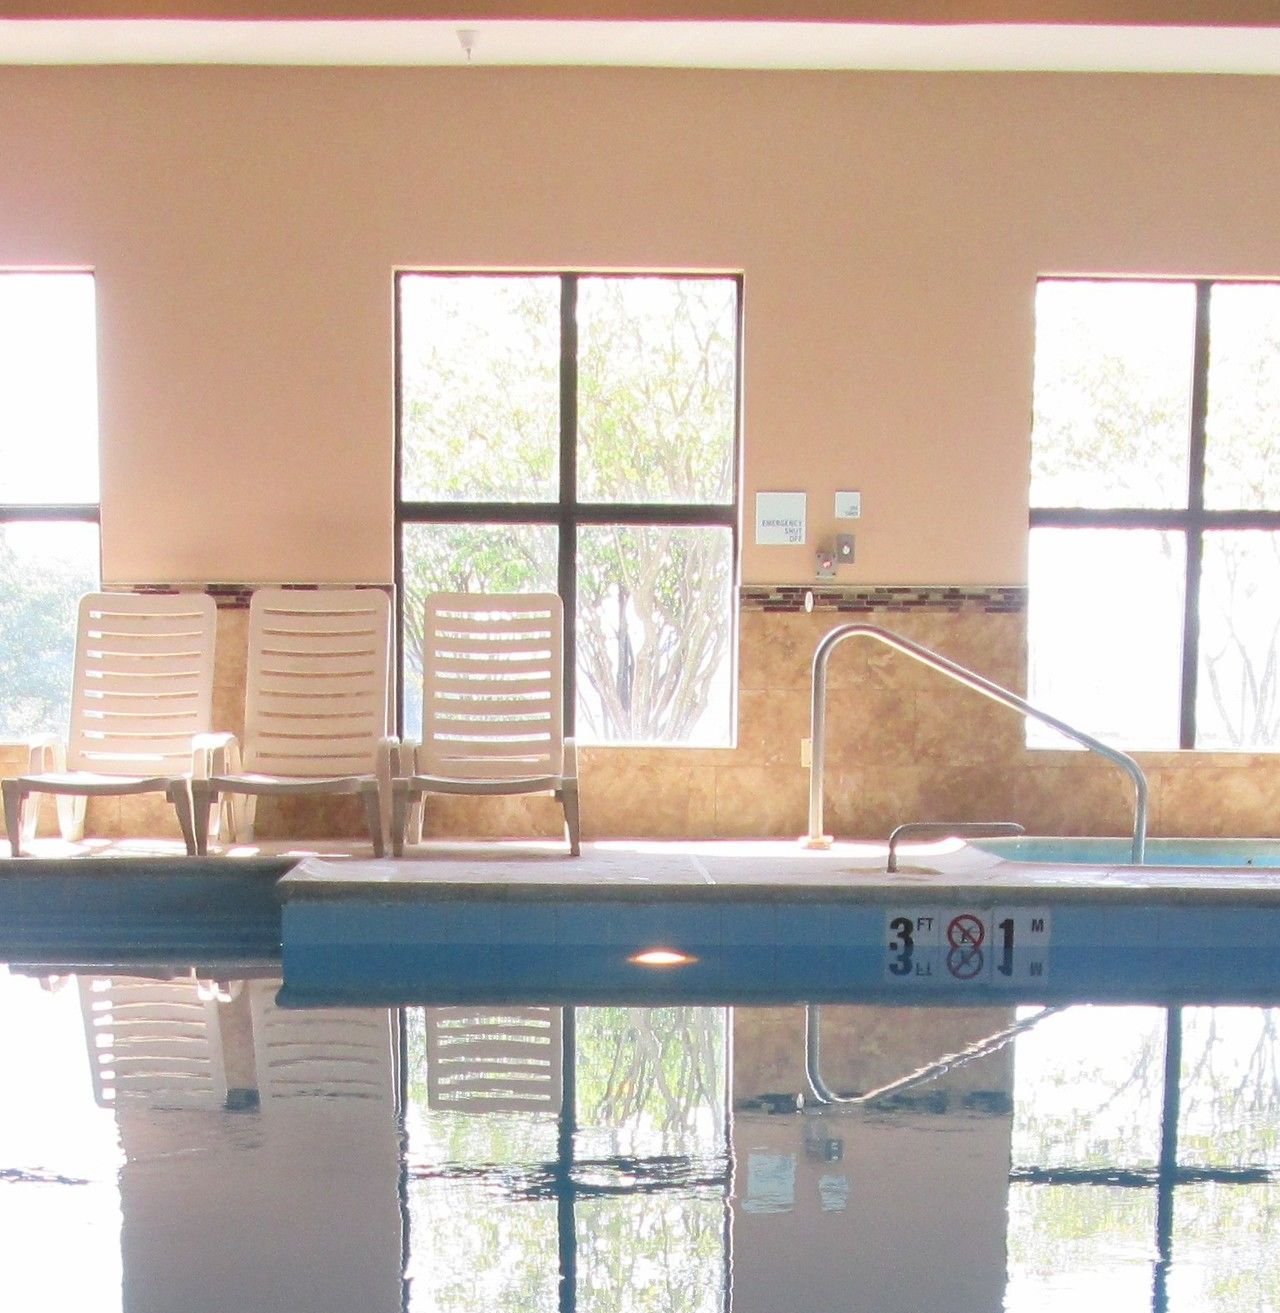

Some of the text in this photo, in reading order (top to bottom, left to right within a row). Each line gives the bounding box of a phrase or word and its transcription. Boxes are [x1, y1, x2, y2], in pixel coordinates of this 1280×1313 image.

[761, 519, 802, 527] EMERGENCY
[889, 917, 1044, 948] 3 FT 1 M
